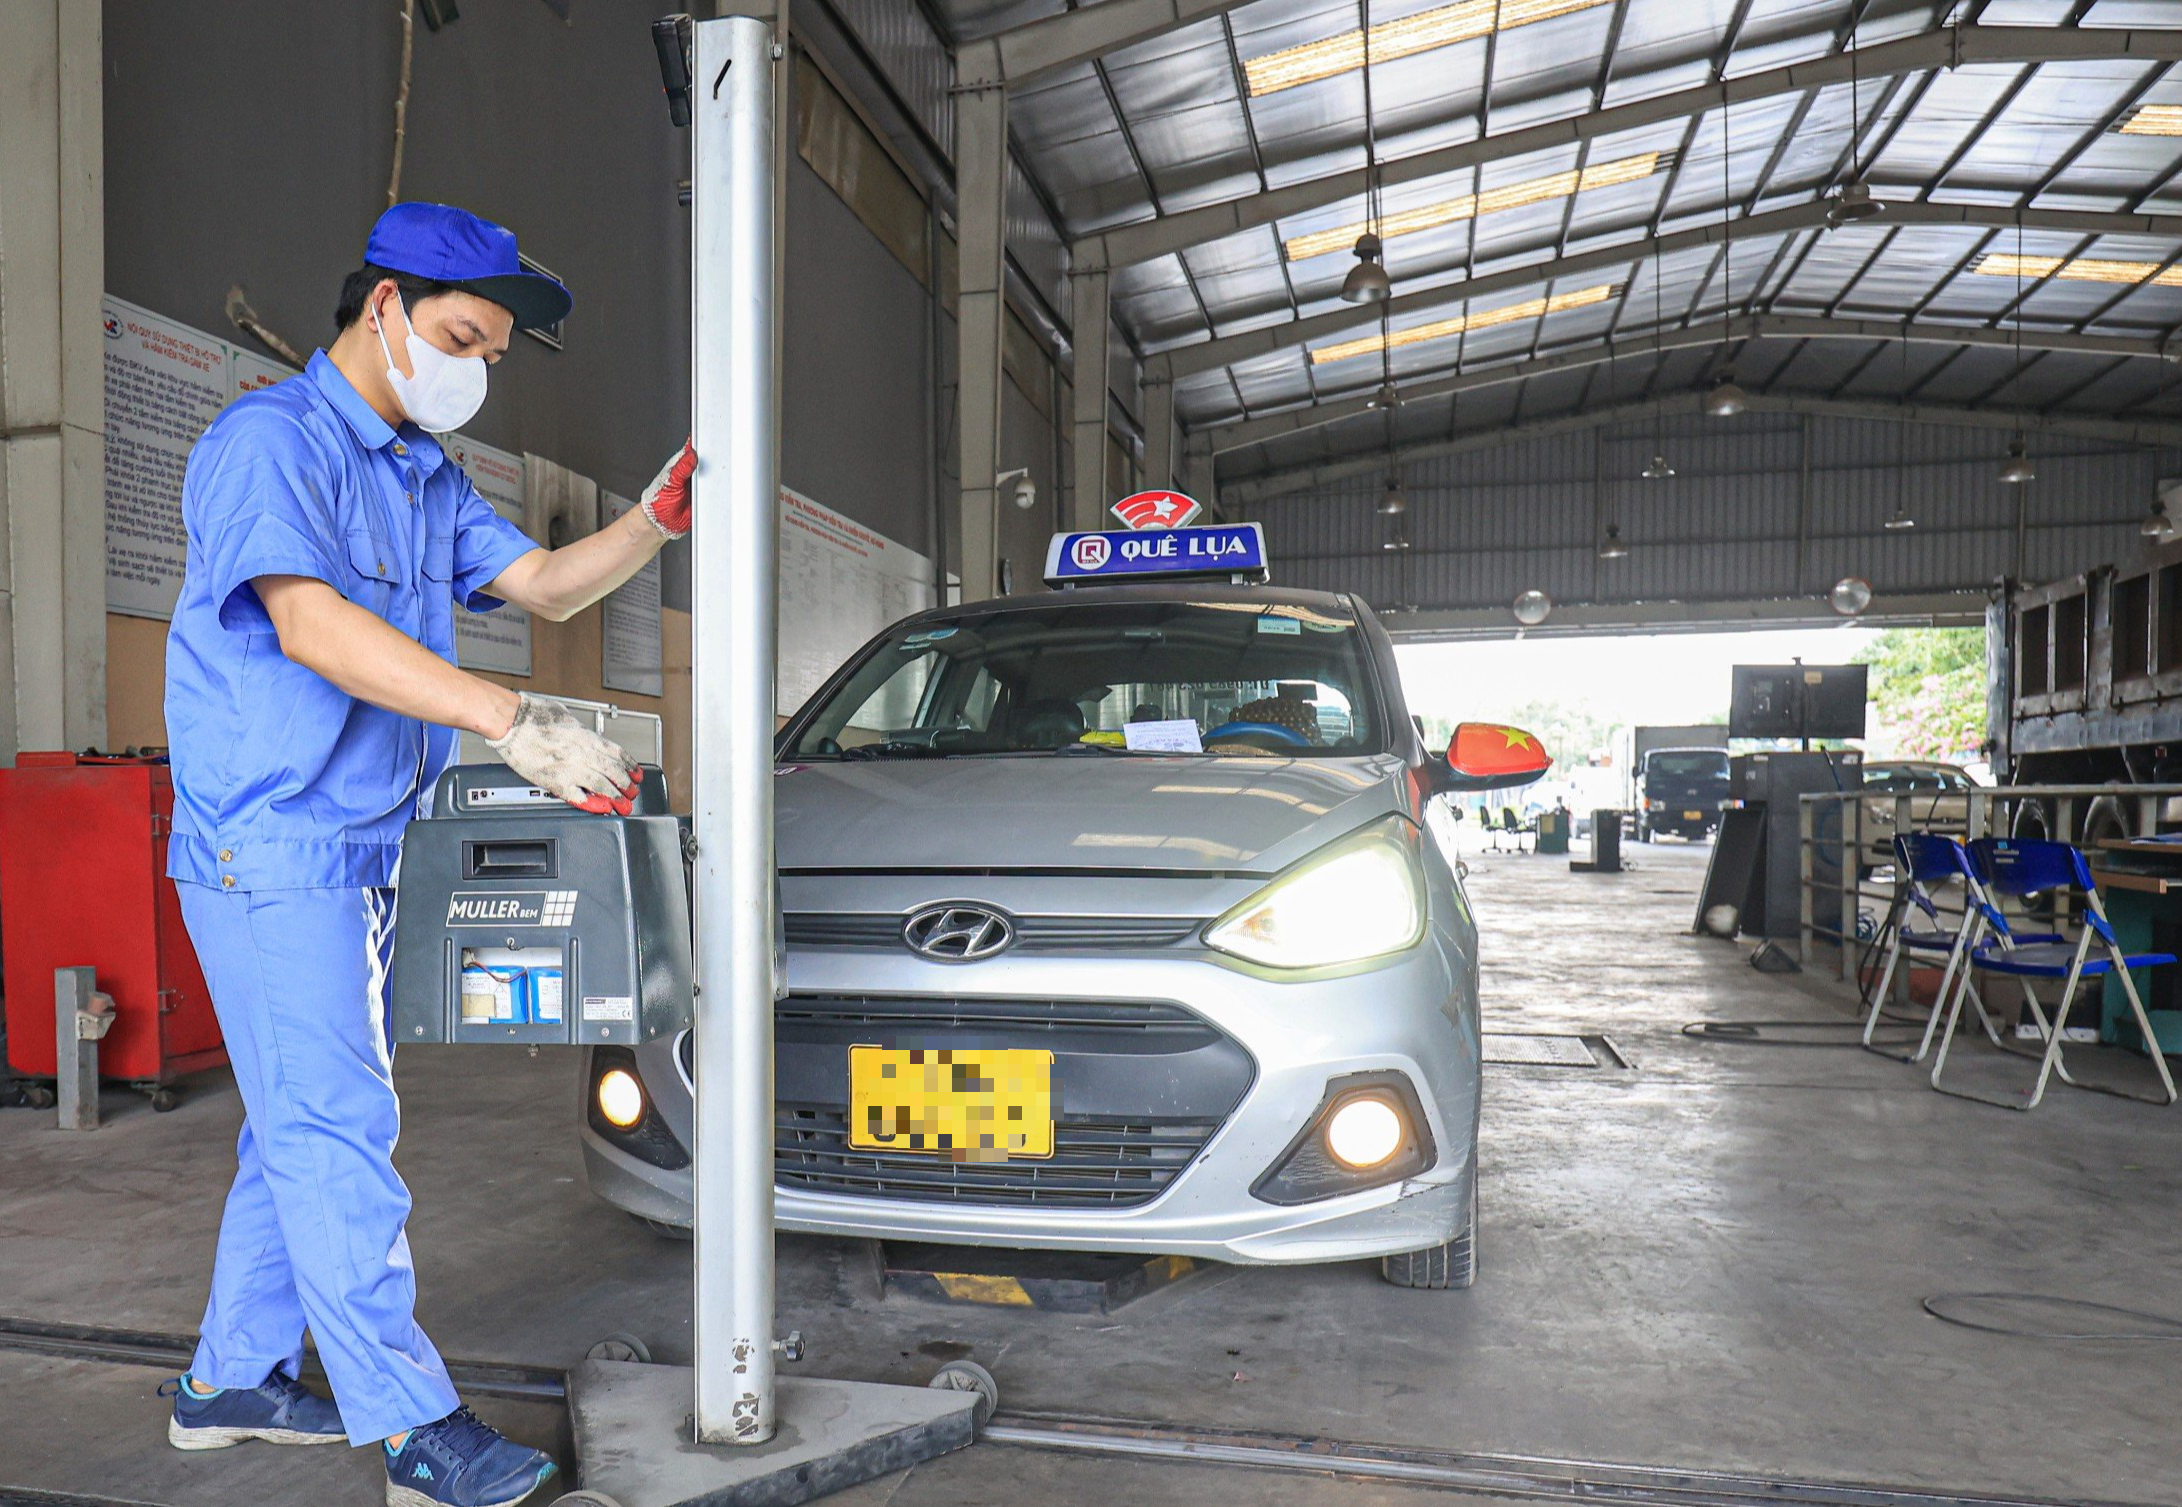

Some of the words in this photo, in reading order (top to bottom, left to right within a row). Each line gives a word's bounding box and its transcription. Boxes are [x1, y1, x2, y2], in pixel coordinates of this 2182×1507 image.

[1120, 534, 1178, 562] QUÊ
[1189, 535, 1247, 561] LỤA
[449, 900, 520, 919] MULLER
[520, 908, 538, 919] BEM
